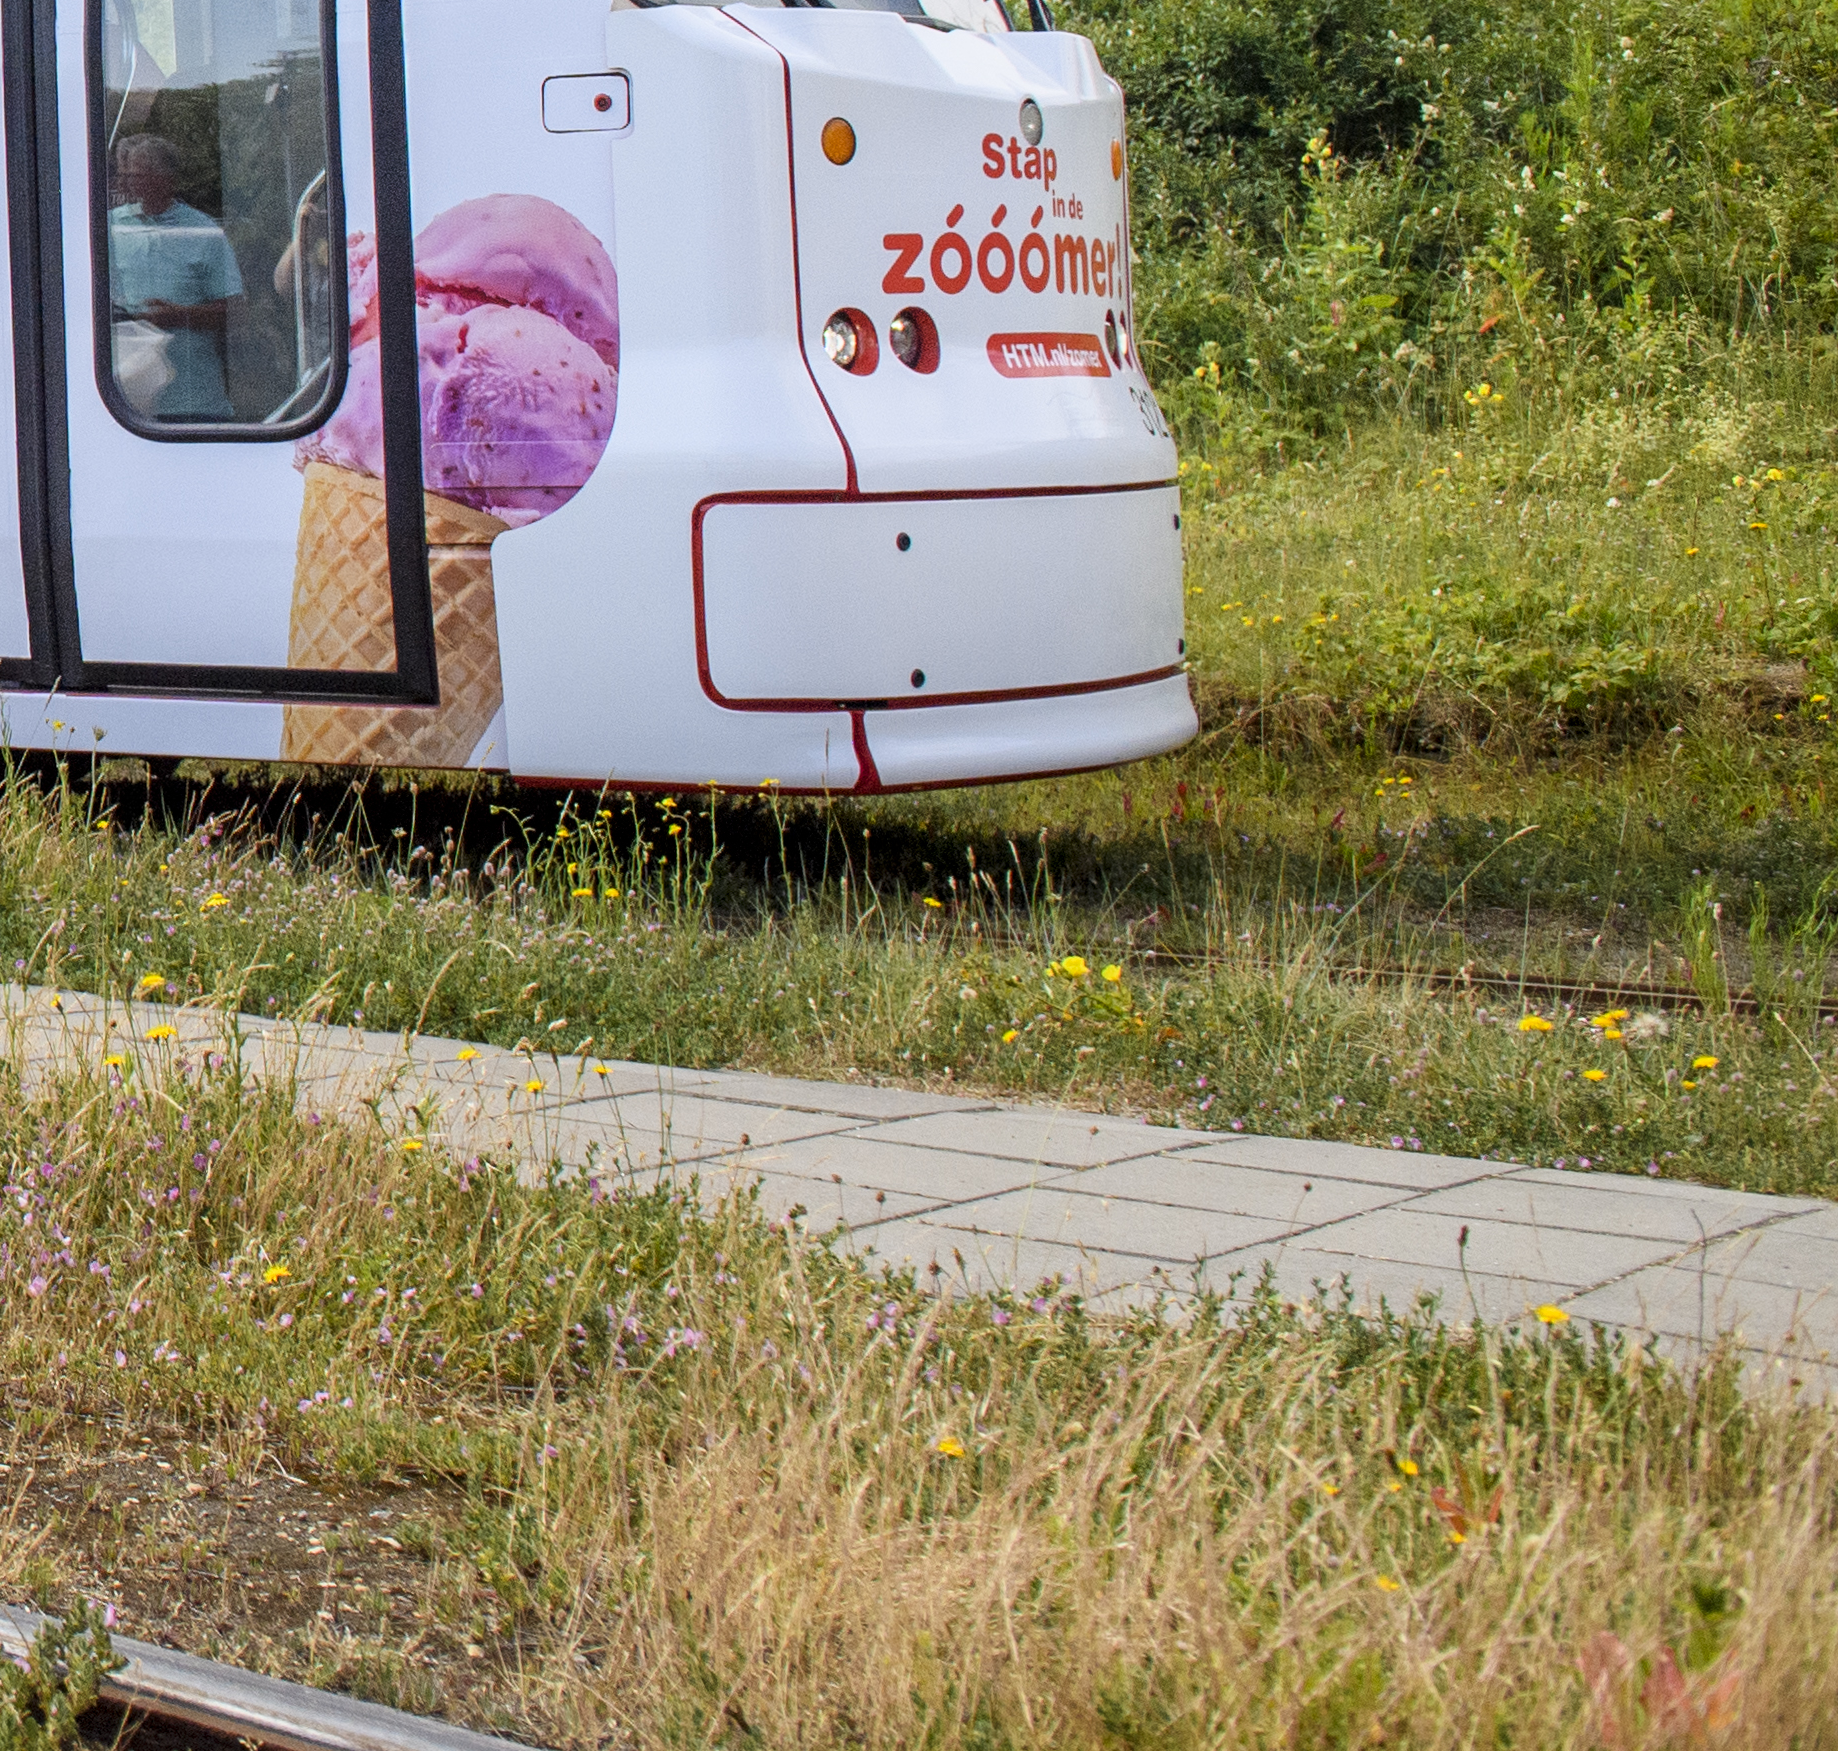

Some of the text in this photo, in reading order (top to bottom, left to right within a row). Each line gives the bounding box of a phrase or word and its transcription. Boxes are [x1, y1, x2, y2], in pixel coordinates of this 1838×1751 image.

[981, 132, 1058, 192] Stap
[1051, 189, 1084, 221] in de
[881, 202, 1123, 300] zóóómer!
[1000, 341, 1104, 370] HTM.nl/zomer
